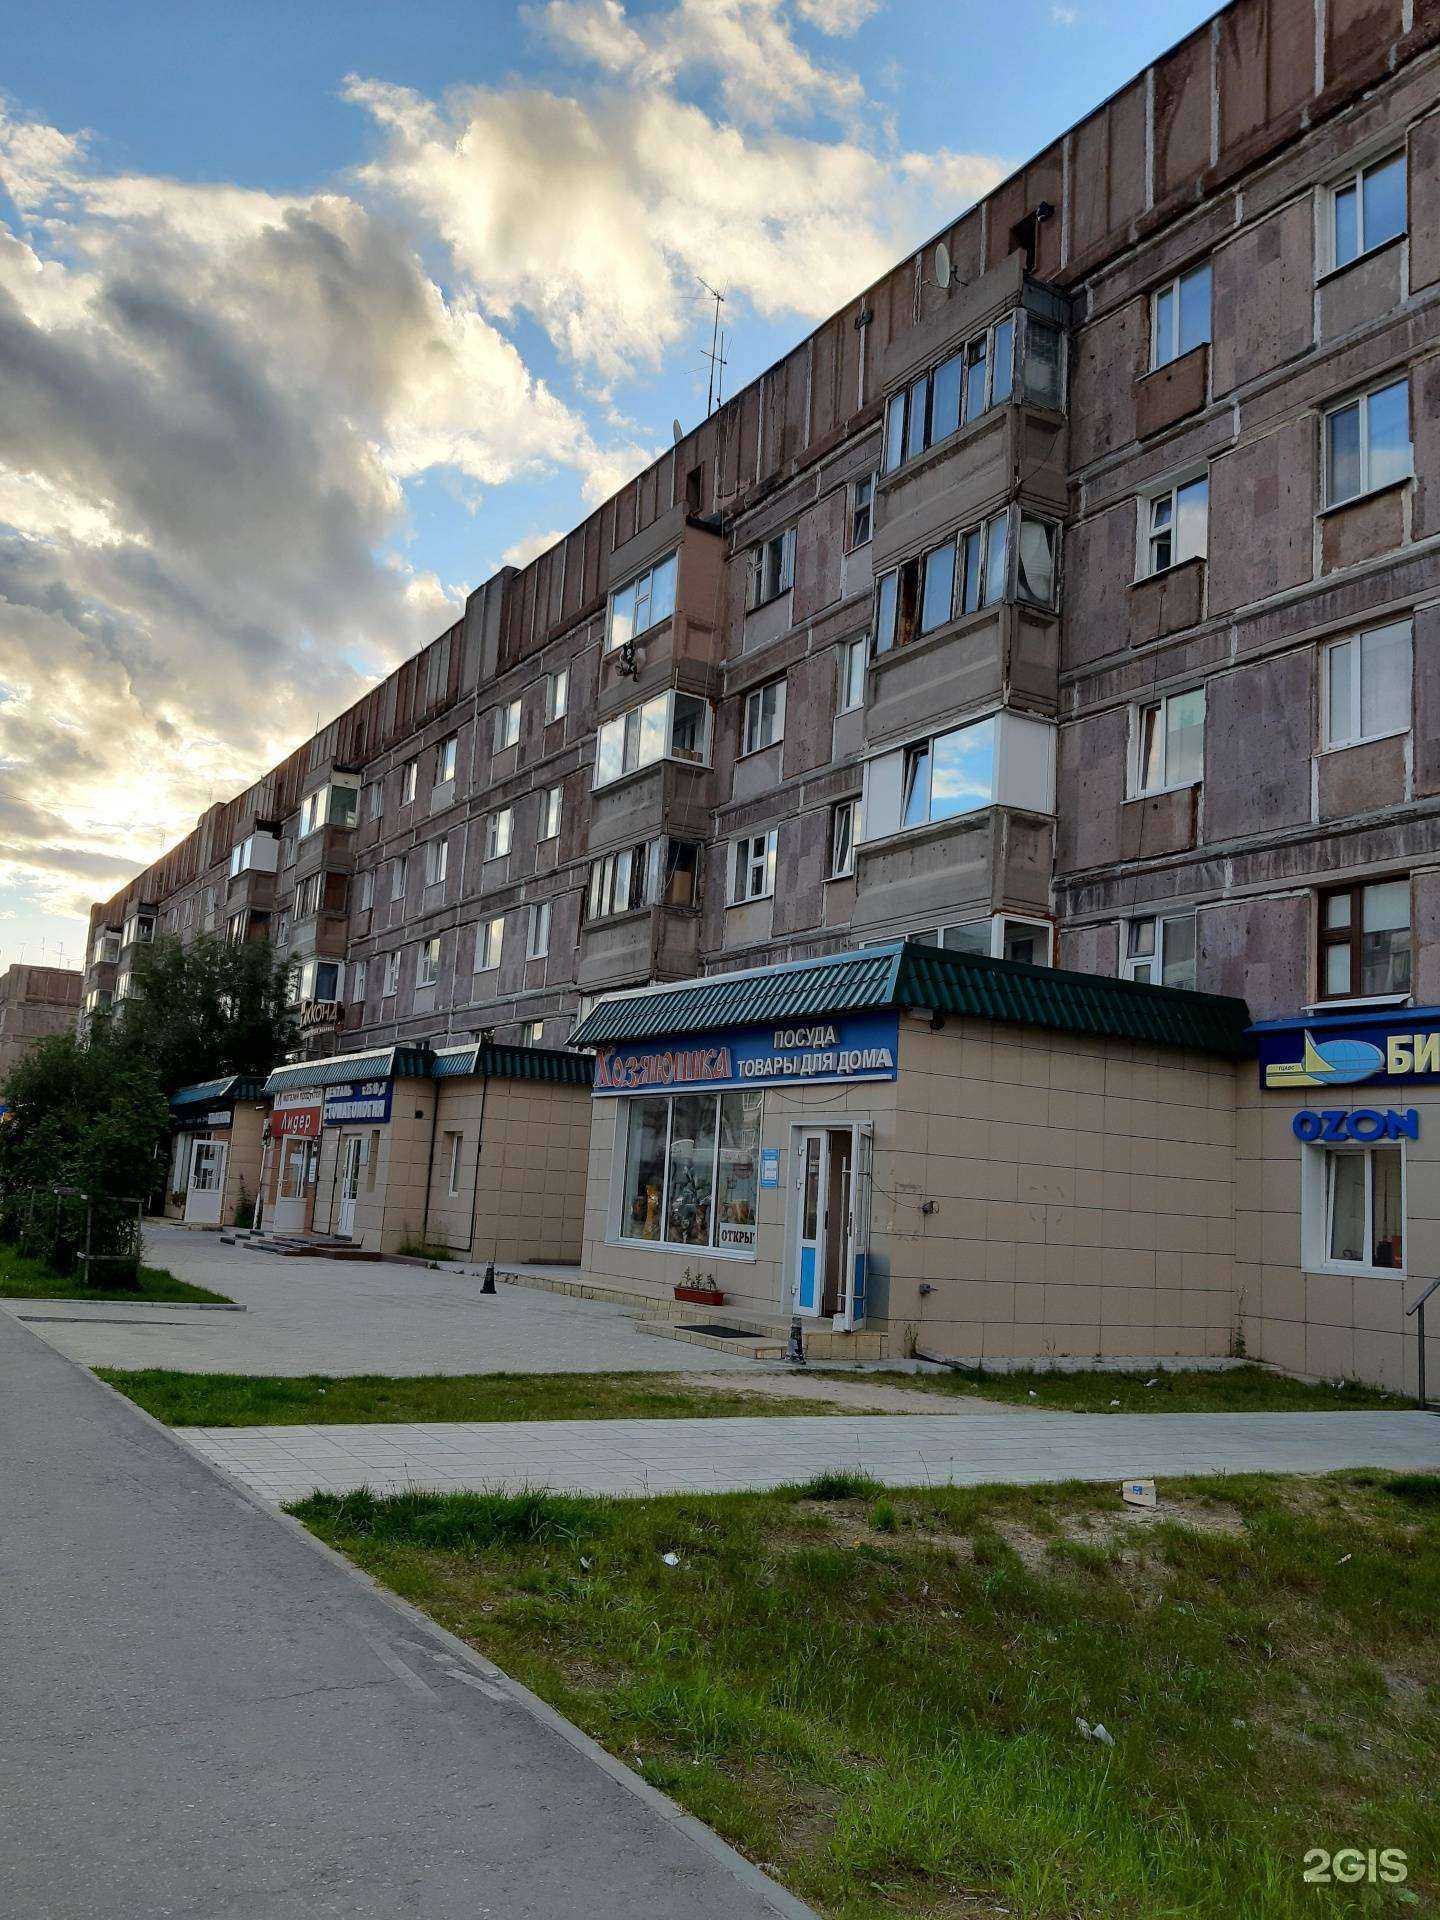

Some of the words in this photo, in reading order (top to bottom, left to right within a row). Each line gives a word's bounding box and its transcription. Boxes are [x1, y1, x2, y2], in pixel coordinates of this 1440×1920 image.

[773, 1025, 838, 1048] ПОСУДА
[737, 1055, 800, 1079] ТОВАРЫ
[800, 1053, 835, 1076] ДЛЯ
[837, 1048, 894, 1074] ДОМА
[281, 1112, 311, 1134] Лидер
[1292, 1108, 1419, 1141] OZON
